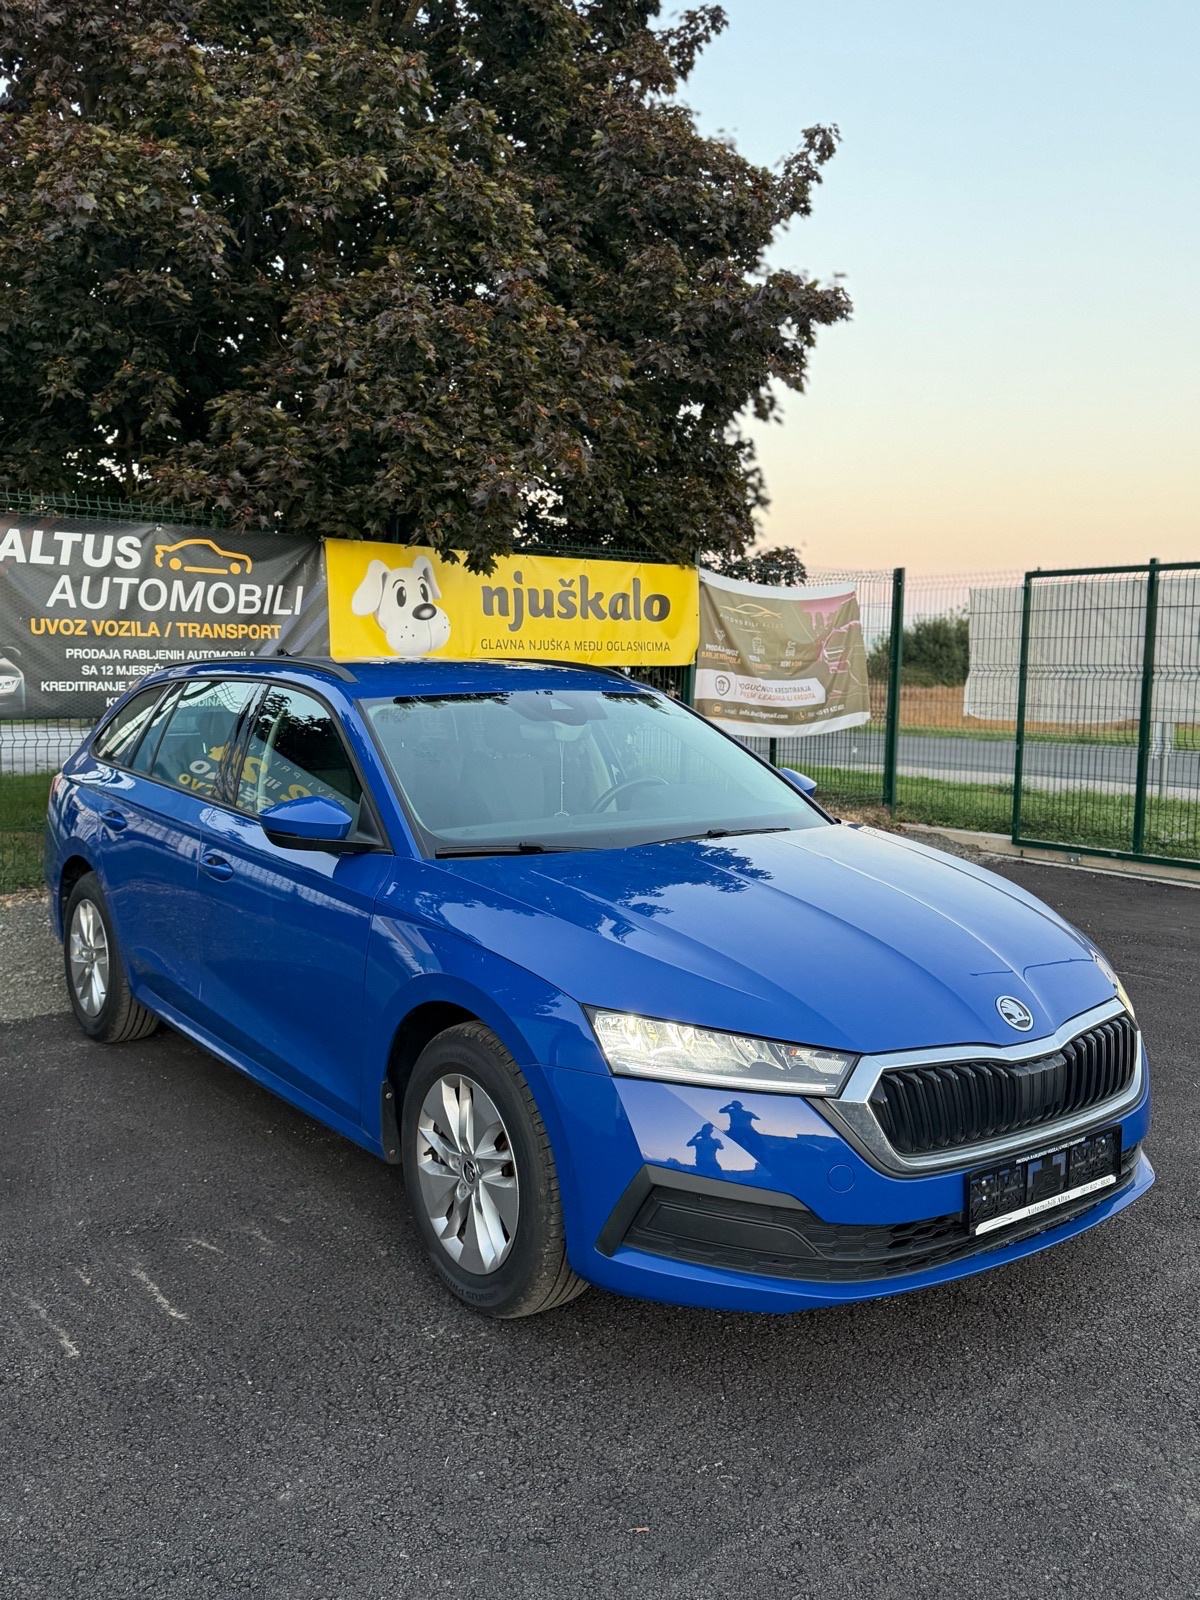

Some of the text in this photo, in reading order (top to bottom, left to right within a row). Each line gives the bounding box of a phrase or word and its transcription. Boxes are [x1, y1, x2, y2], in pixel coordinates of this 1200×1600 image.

[0, 528, 142, 569] ALTUS
[46, 574, 304, 616] AUTOMOBILI
[481, 570, 671, 632] njuškalo
[30, 618, 88, 636] UVOZ
[94, 619, 161, 638] VOZILA
[176, 622, 282, 640] TRANSPORT
[65, 648, 122, 661] PRODAJA
[123, 649, 185, 661] RABLJENIH
[480, 638, 525, 650] GLAVNA
[529, 637, 570, 651] NJUŠKA
[606, 642, 671, 653] OGLASNICIMA
[81, 665, 98, 676] SA
[100, 665, 114, 676] 12
[41, 681, 126, 692] KREDITIRANJE
